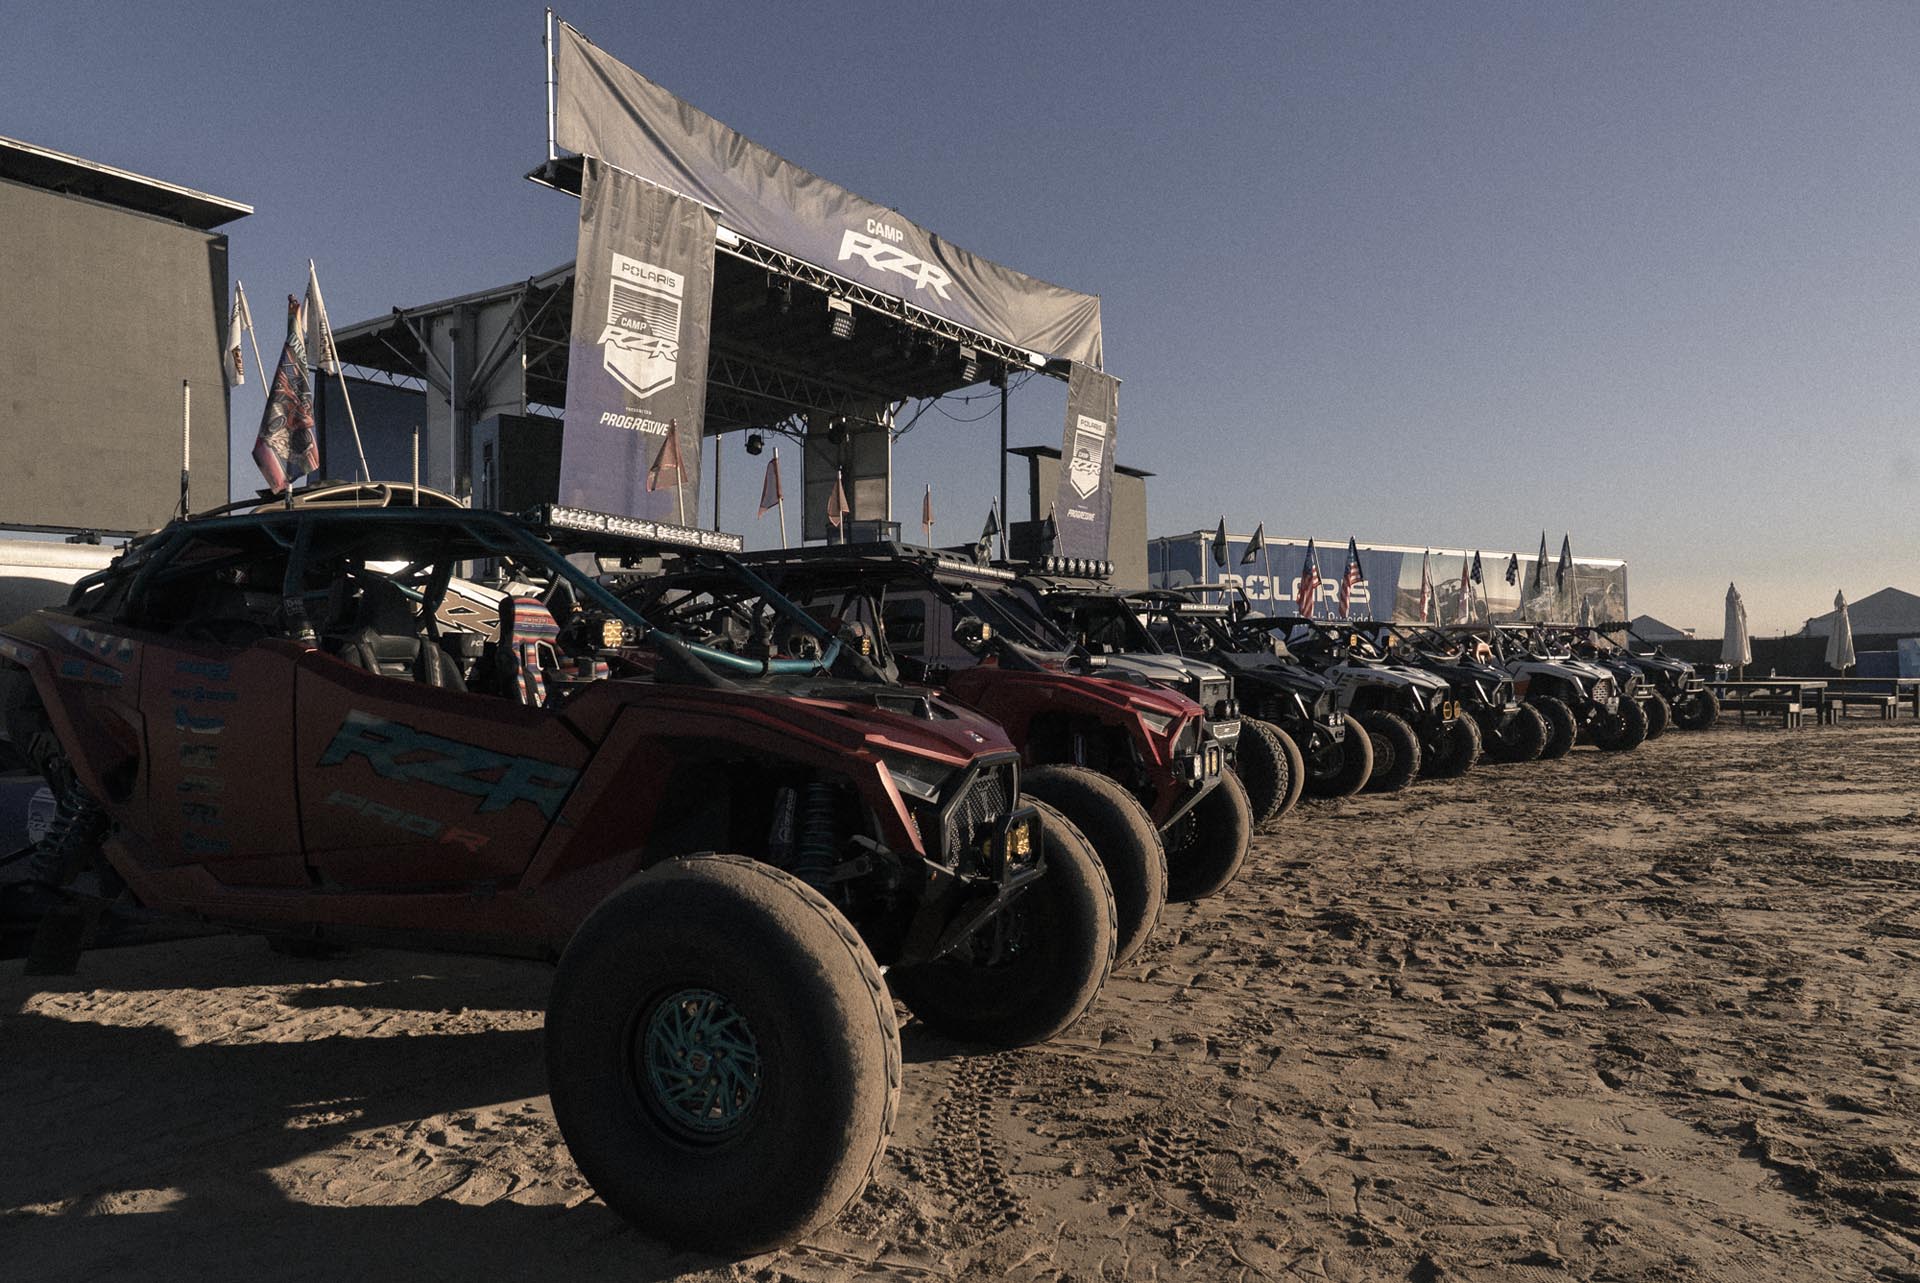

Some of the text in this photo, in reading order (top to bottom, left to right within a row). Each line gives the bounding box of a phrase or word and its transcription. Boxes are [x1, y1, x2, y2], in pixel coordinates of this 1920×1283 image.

[867, 218, 903, 243] CAMP
[621, 262, 676, 288] POLARIS
[837, 229, 952, 301] RZR
[620, 317, 647, 331] CAMP
[597, 325, 680, 362] RZR
[600, 411, 670, 437] PROGRESSIVE
[1069, 457, 1102, 476] RZR
[1219, 574, 1370, 603] POLARS
[316, 708, 576, 827] RZR
